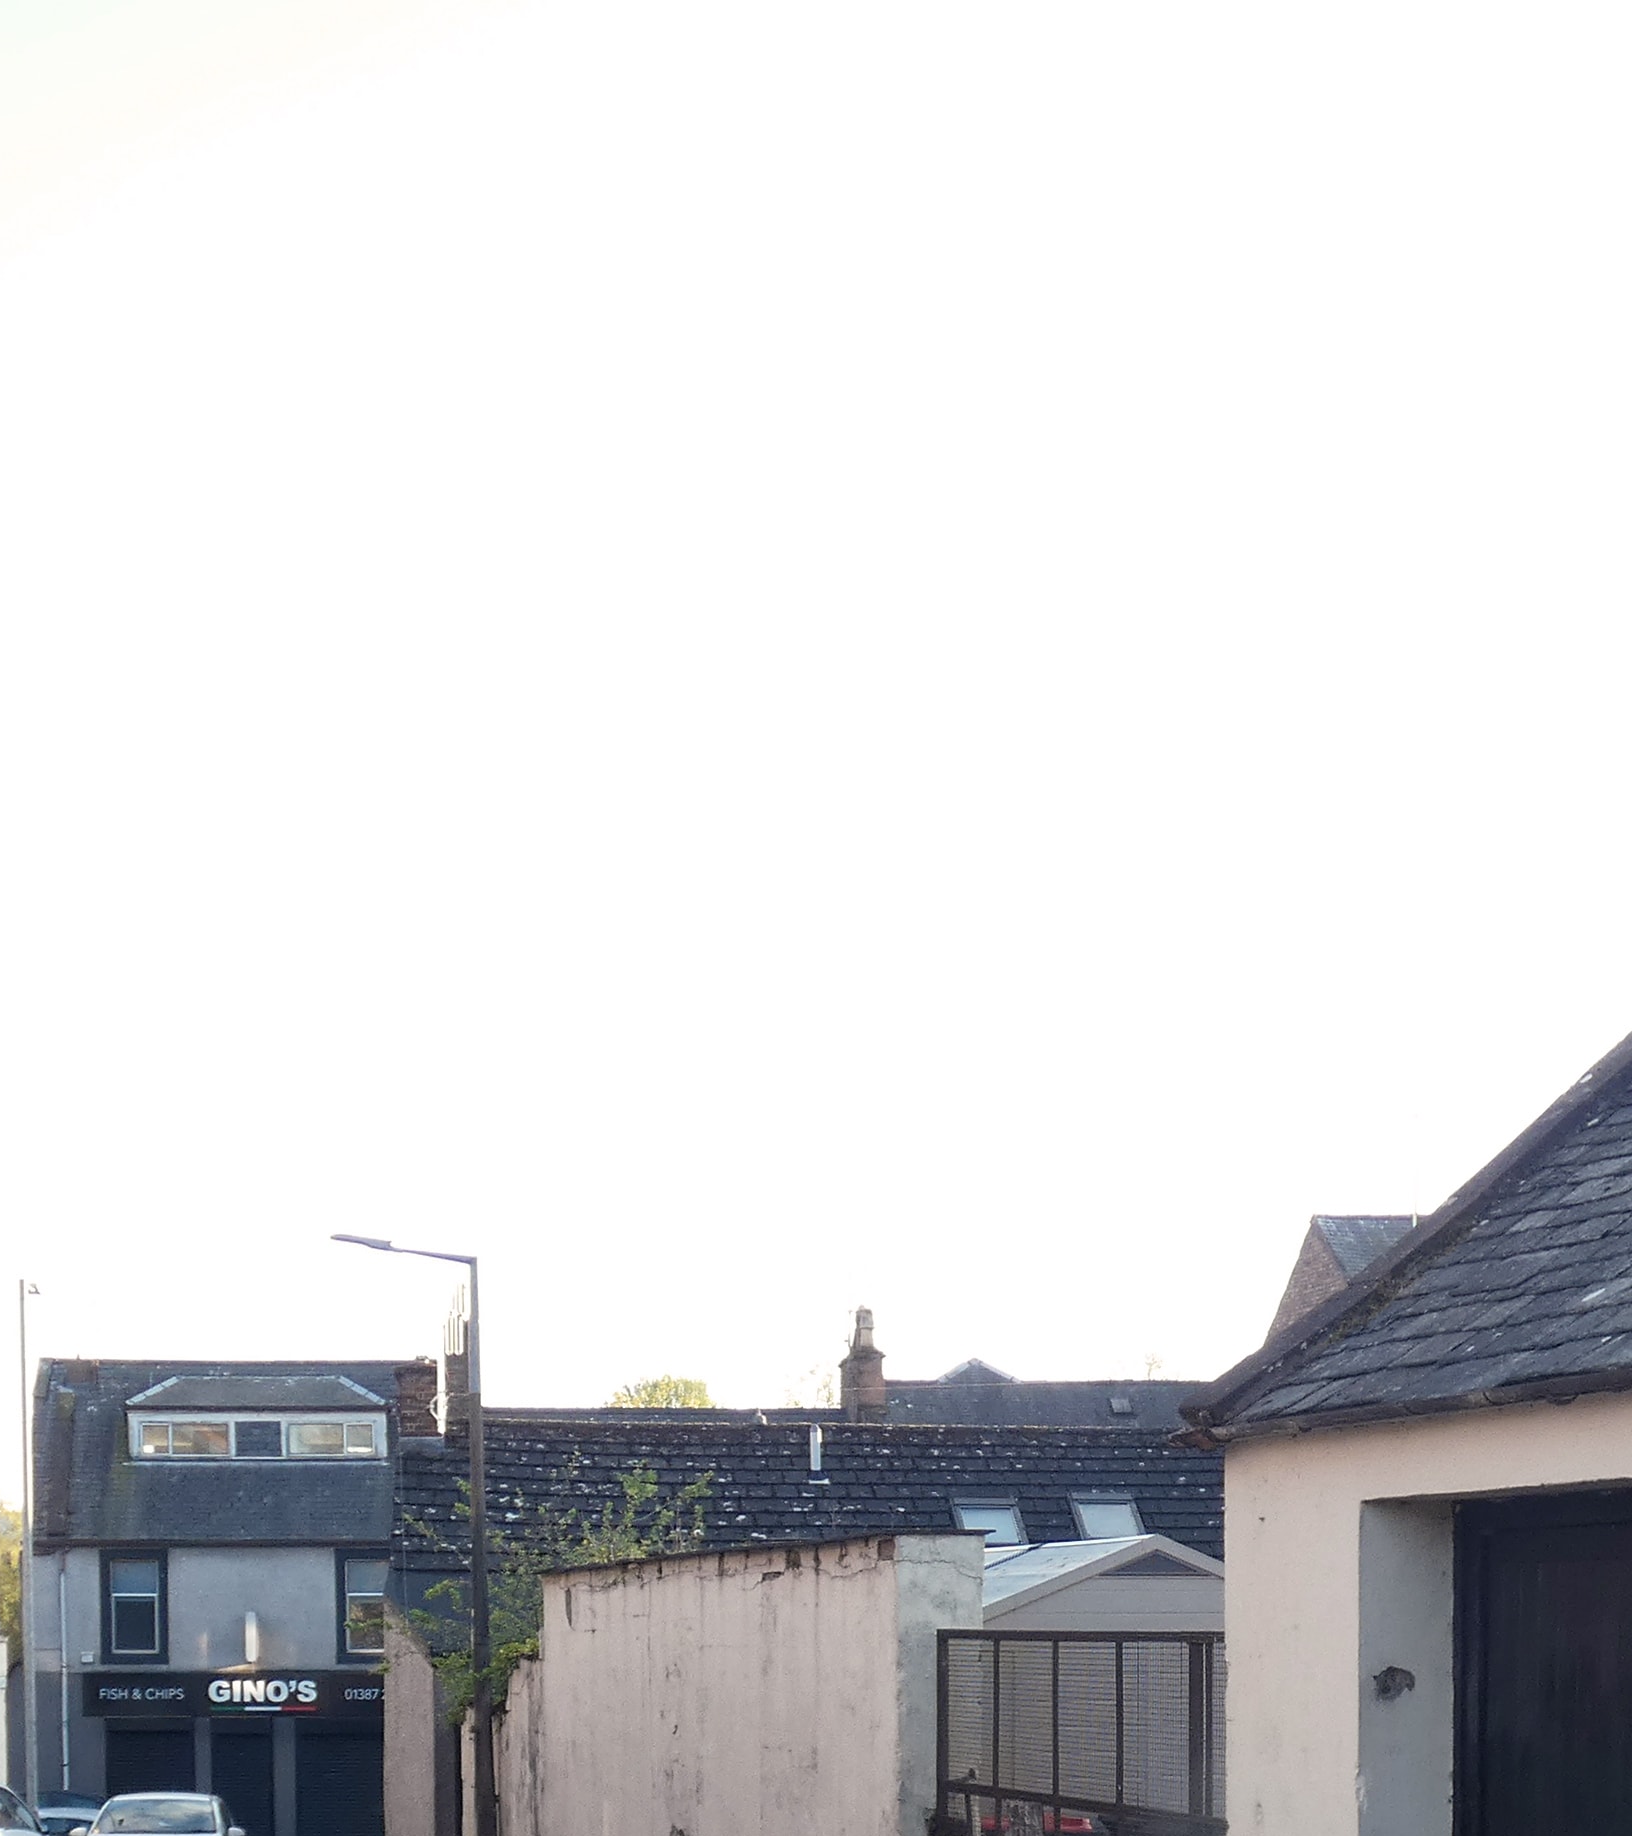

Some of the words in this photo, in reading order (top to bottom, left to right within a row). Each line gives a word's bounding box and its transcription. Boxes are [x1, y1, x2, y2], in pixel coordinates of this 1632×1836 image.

[99, 1688, 128, 1700] FISH
[131, 1688, 143, 1700] &
[145, 1687, 185, 1701] CHIPS
[208, 1679, 317, 1703] GINO'S
[344, 1688, 379, 1700] 01387
